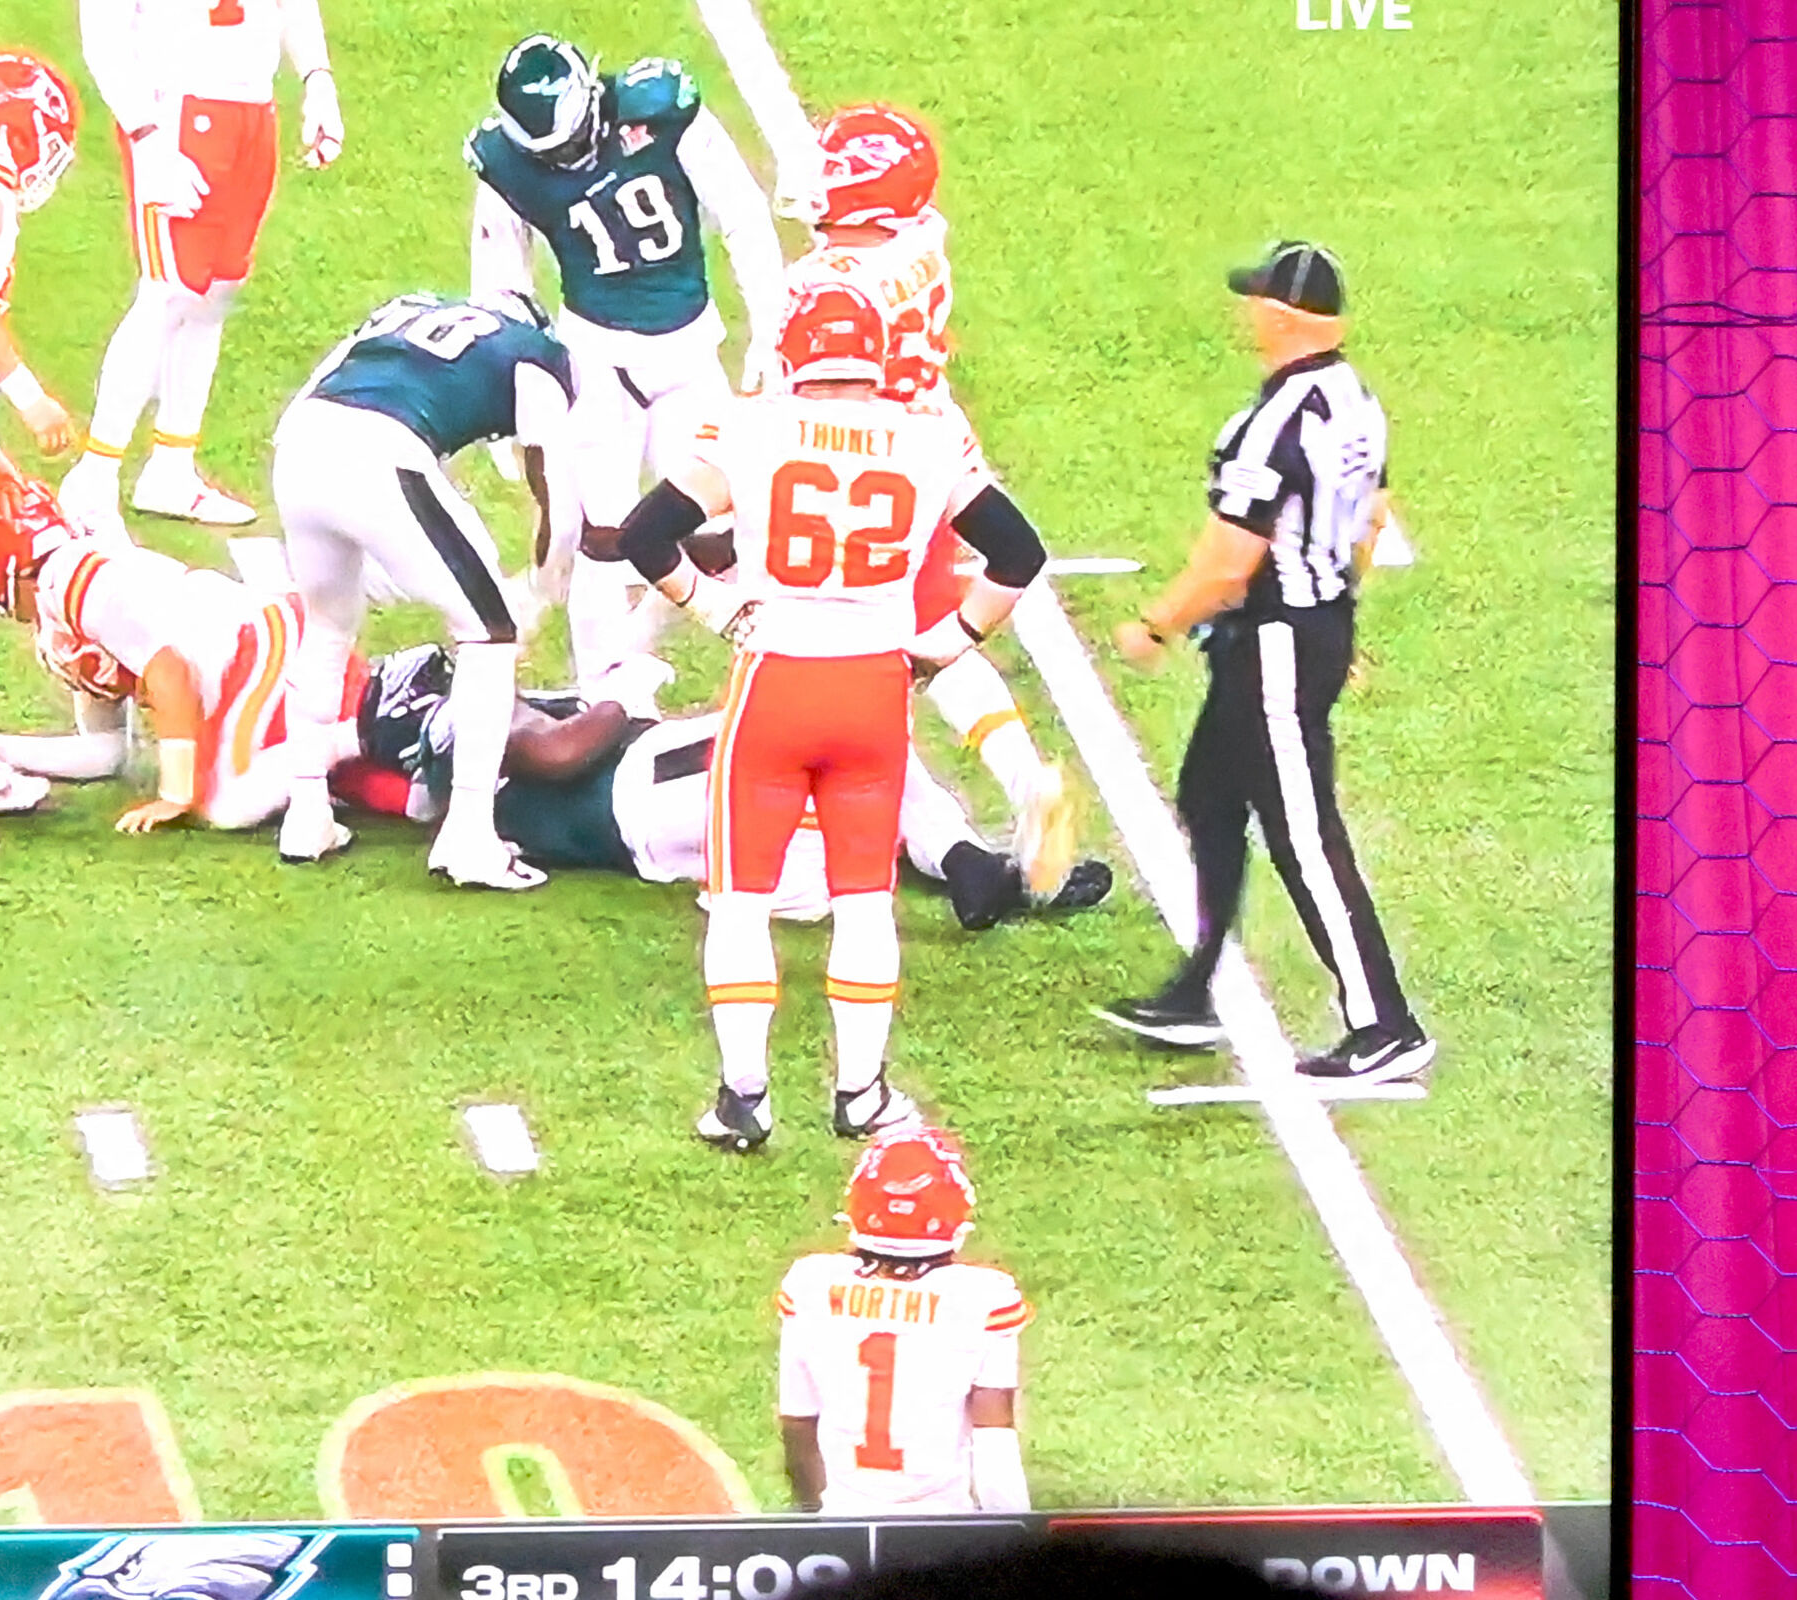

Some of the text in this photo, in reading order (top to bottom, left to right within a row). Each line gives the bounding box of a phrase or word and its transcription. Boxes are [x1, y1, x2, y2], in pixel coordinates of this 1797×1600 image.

[1296, 0, 1413, 30] LIVE
[568, 174, 683, 275] 19
[798, 420, 896, 457] THUNEY
[766, 460, 917, 589] 62
[828, 1284, 940, 1325] WORTHY
[855, 1331, 905, 1472] 1
[1263, 1552, 1476, 1593] DOWN
